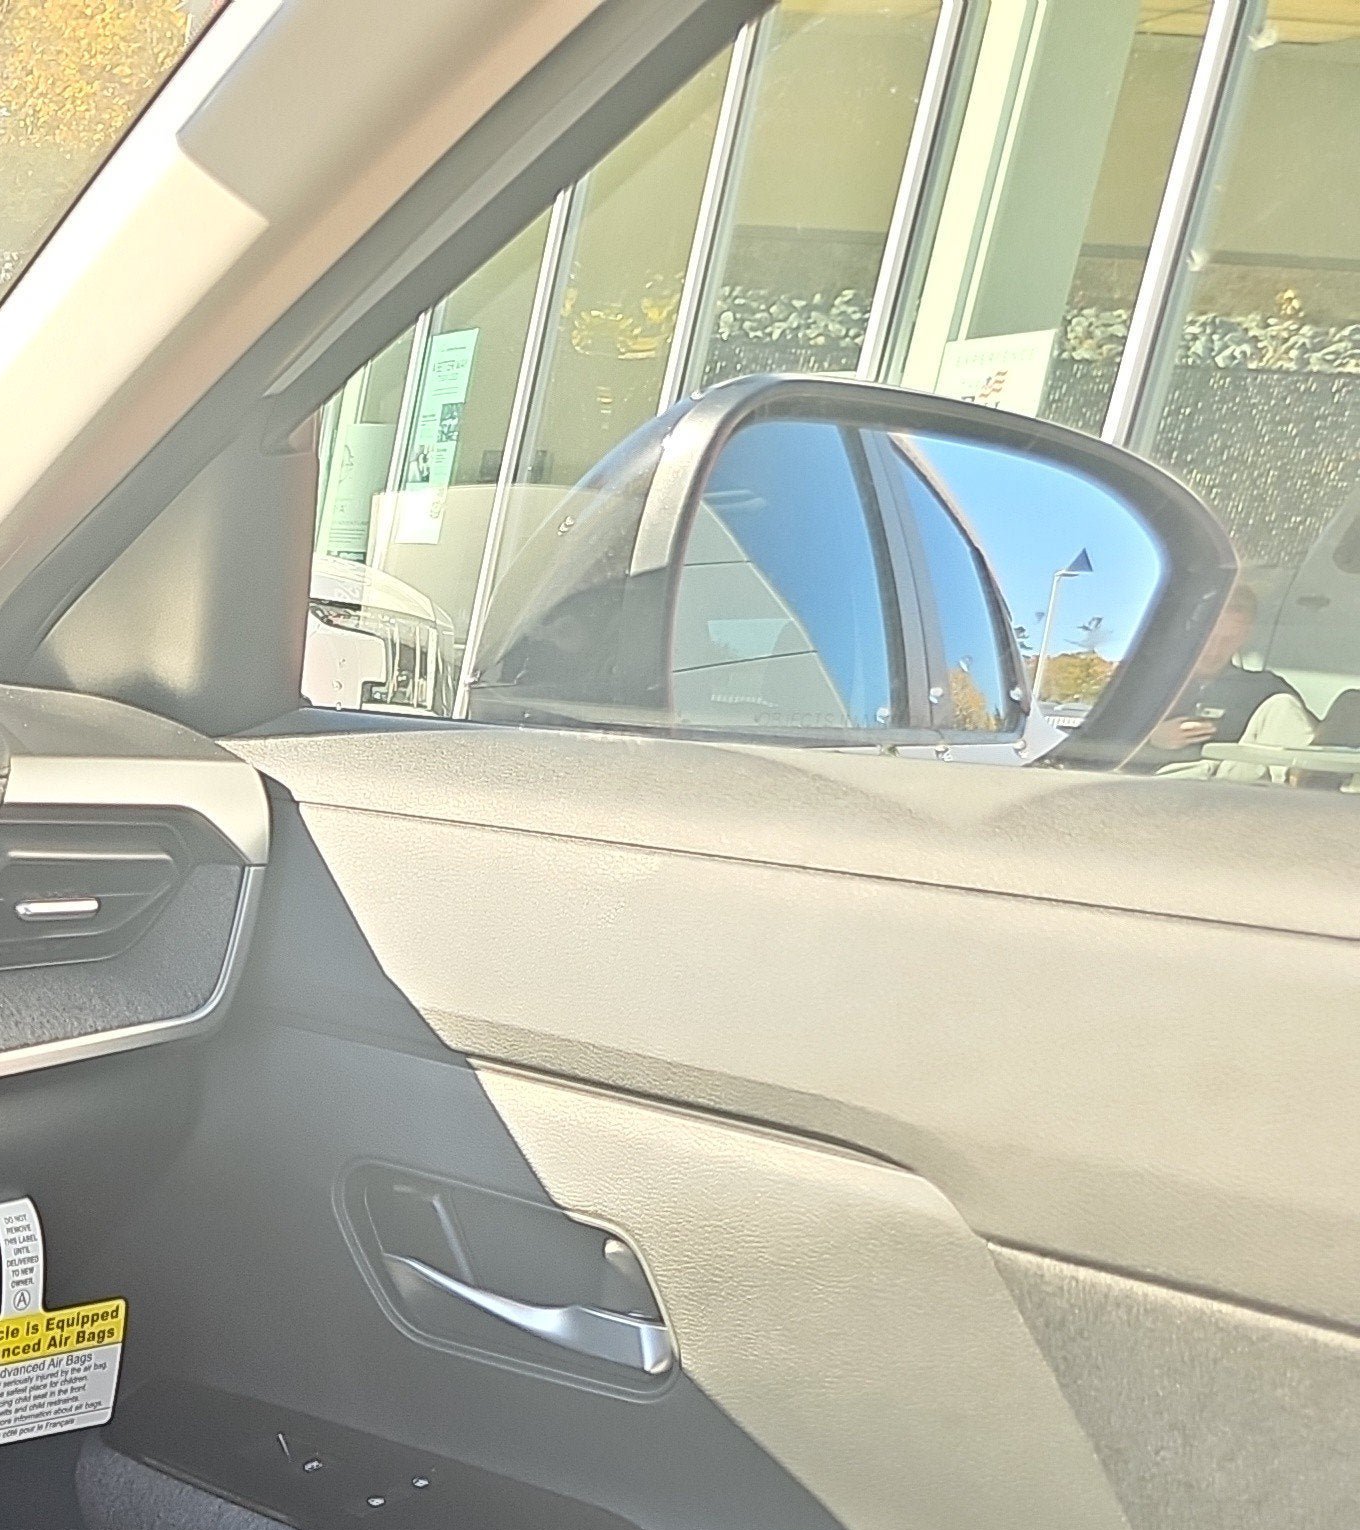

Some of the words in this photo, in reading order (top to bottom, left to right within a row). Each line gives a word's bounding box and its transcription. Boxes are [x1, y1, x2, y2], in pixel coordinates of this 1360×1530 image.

[25, 1321, 40, 1337] is
[45, 1304, 120, 1334] Equipped
[46, 1333, 71, 1352] Air
[76, 1325, 116, 1346] Bags
[47, 1357, 64, 1370] Air
[65, 1353, 93, 1367] Bags
